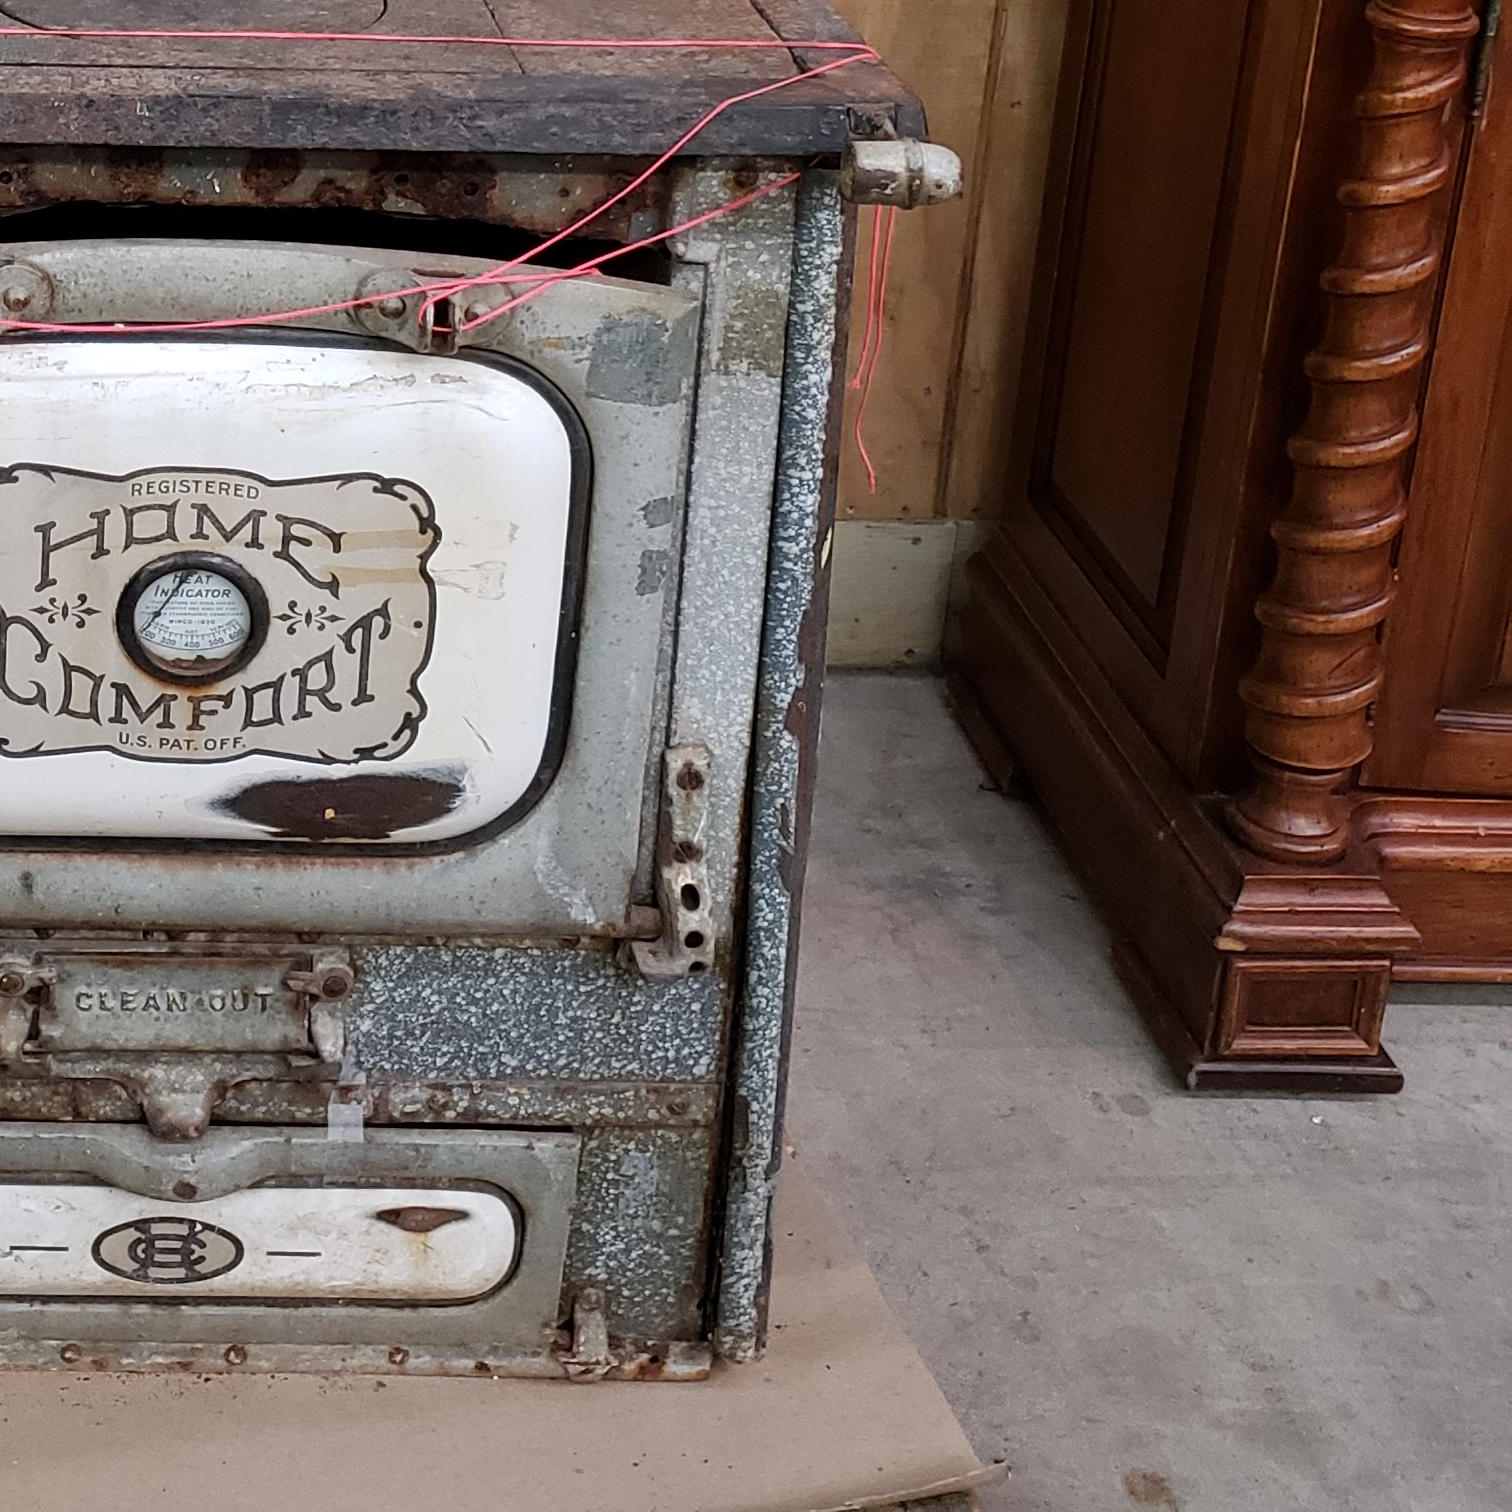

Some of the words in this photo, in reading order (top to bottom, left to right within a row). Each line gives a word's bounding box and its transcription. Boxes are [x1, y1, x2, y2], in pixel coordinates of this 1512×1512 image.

[130, 479, 261, 500] REGISTERED
[33, 498, 346, 599] HOME
[172, 573, 214, 585] HEAT
[154, 585, 232, 599] INDICATOR
[160, 637, 177, 646] 300
[209, 637, 225, 647] 500
[118, 733, 152, 749] U.S.
[155, 734, 199, 752] PAT.
[203, 735, 247, 752] OFF.
[74, 988, 188, 1013] CLEAN
[209, 986, 275, 1013] OUT
